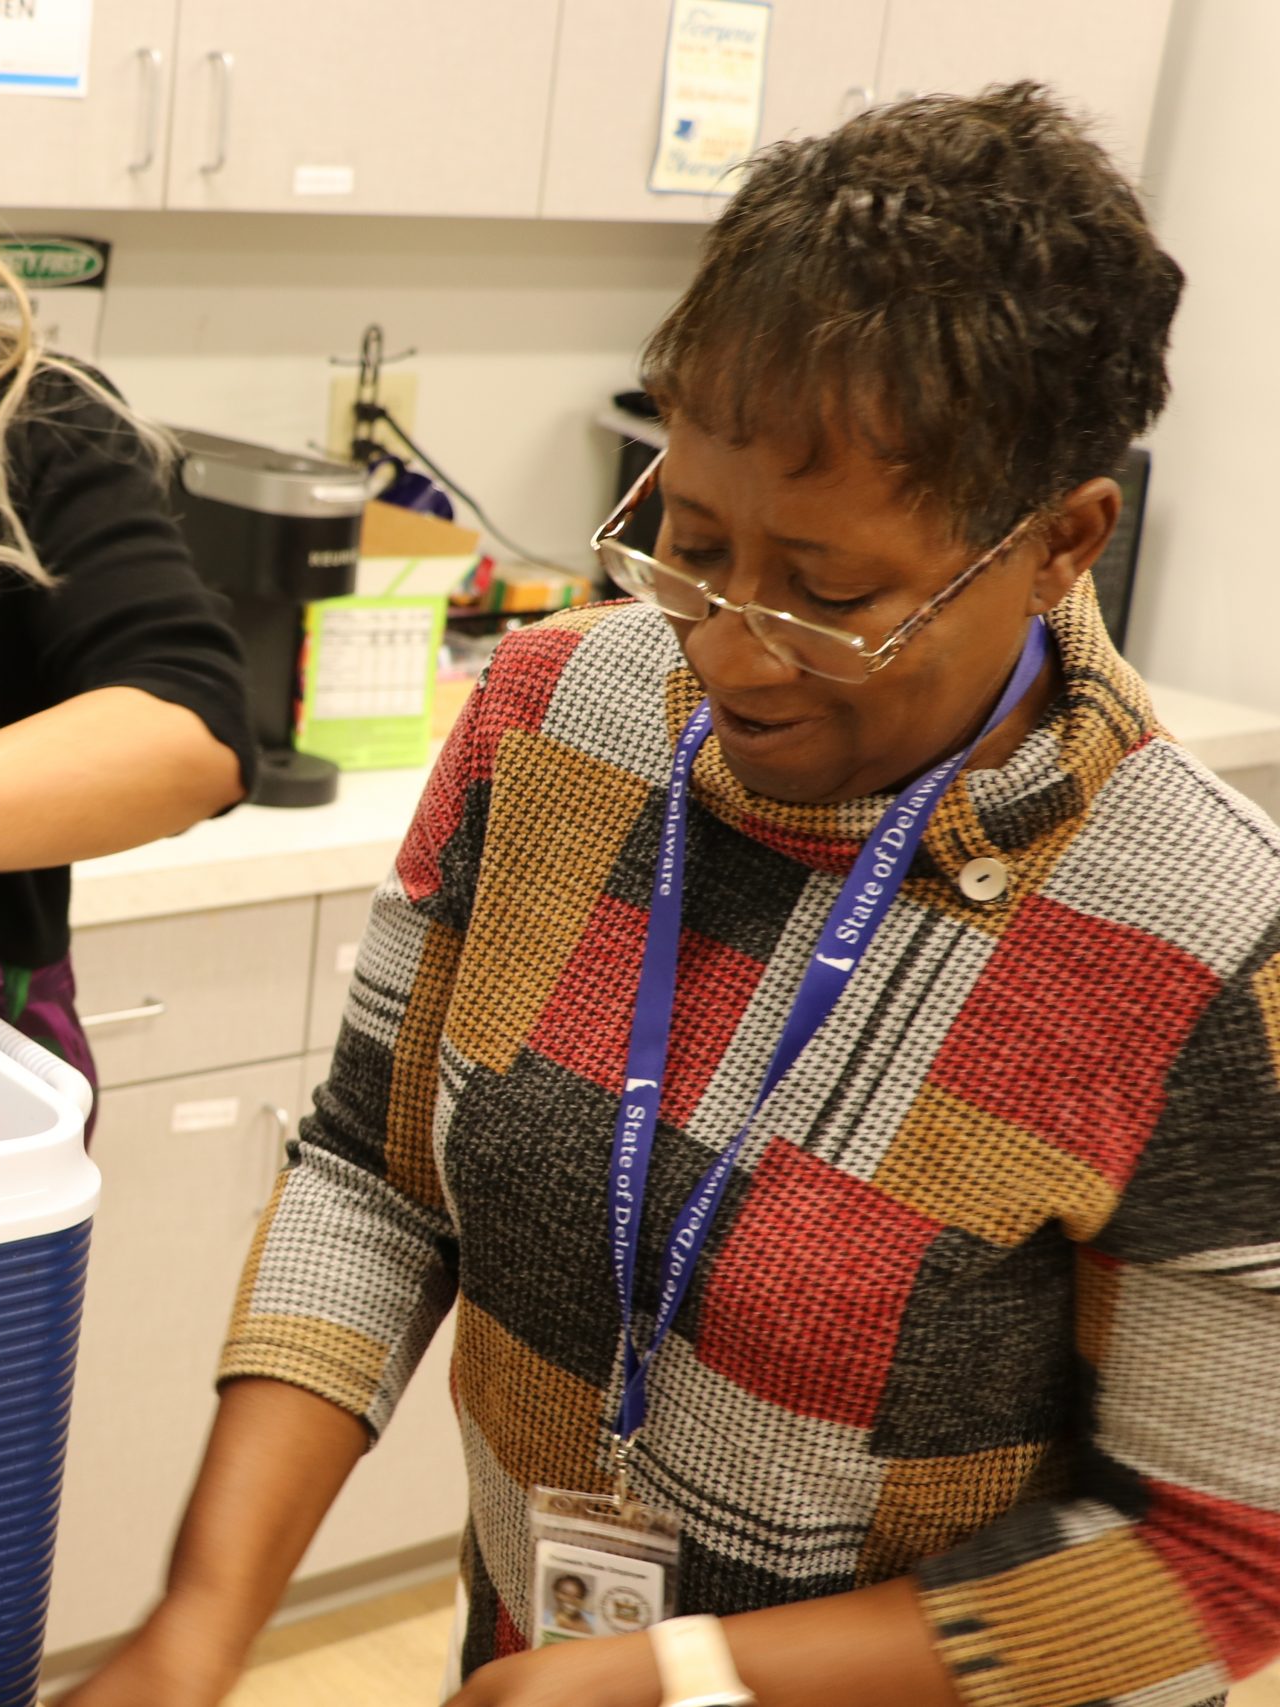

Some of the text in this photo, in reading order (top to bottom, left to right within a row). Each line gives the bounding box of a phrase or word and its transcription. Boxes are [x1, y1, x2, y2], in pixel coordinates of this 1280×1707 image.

[658, 705, 712, 897] tate of Delaware
[835, 881, 885, 945] State
[873, 846, 899, 879] of
[617, 1104, 647, 1169] State
[616, 1174, 634, 1203] of
[669, 1246, 687, 1277] of
